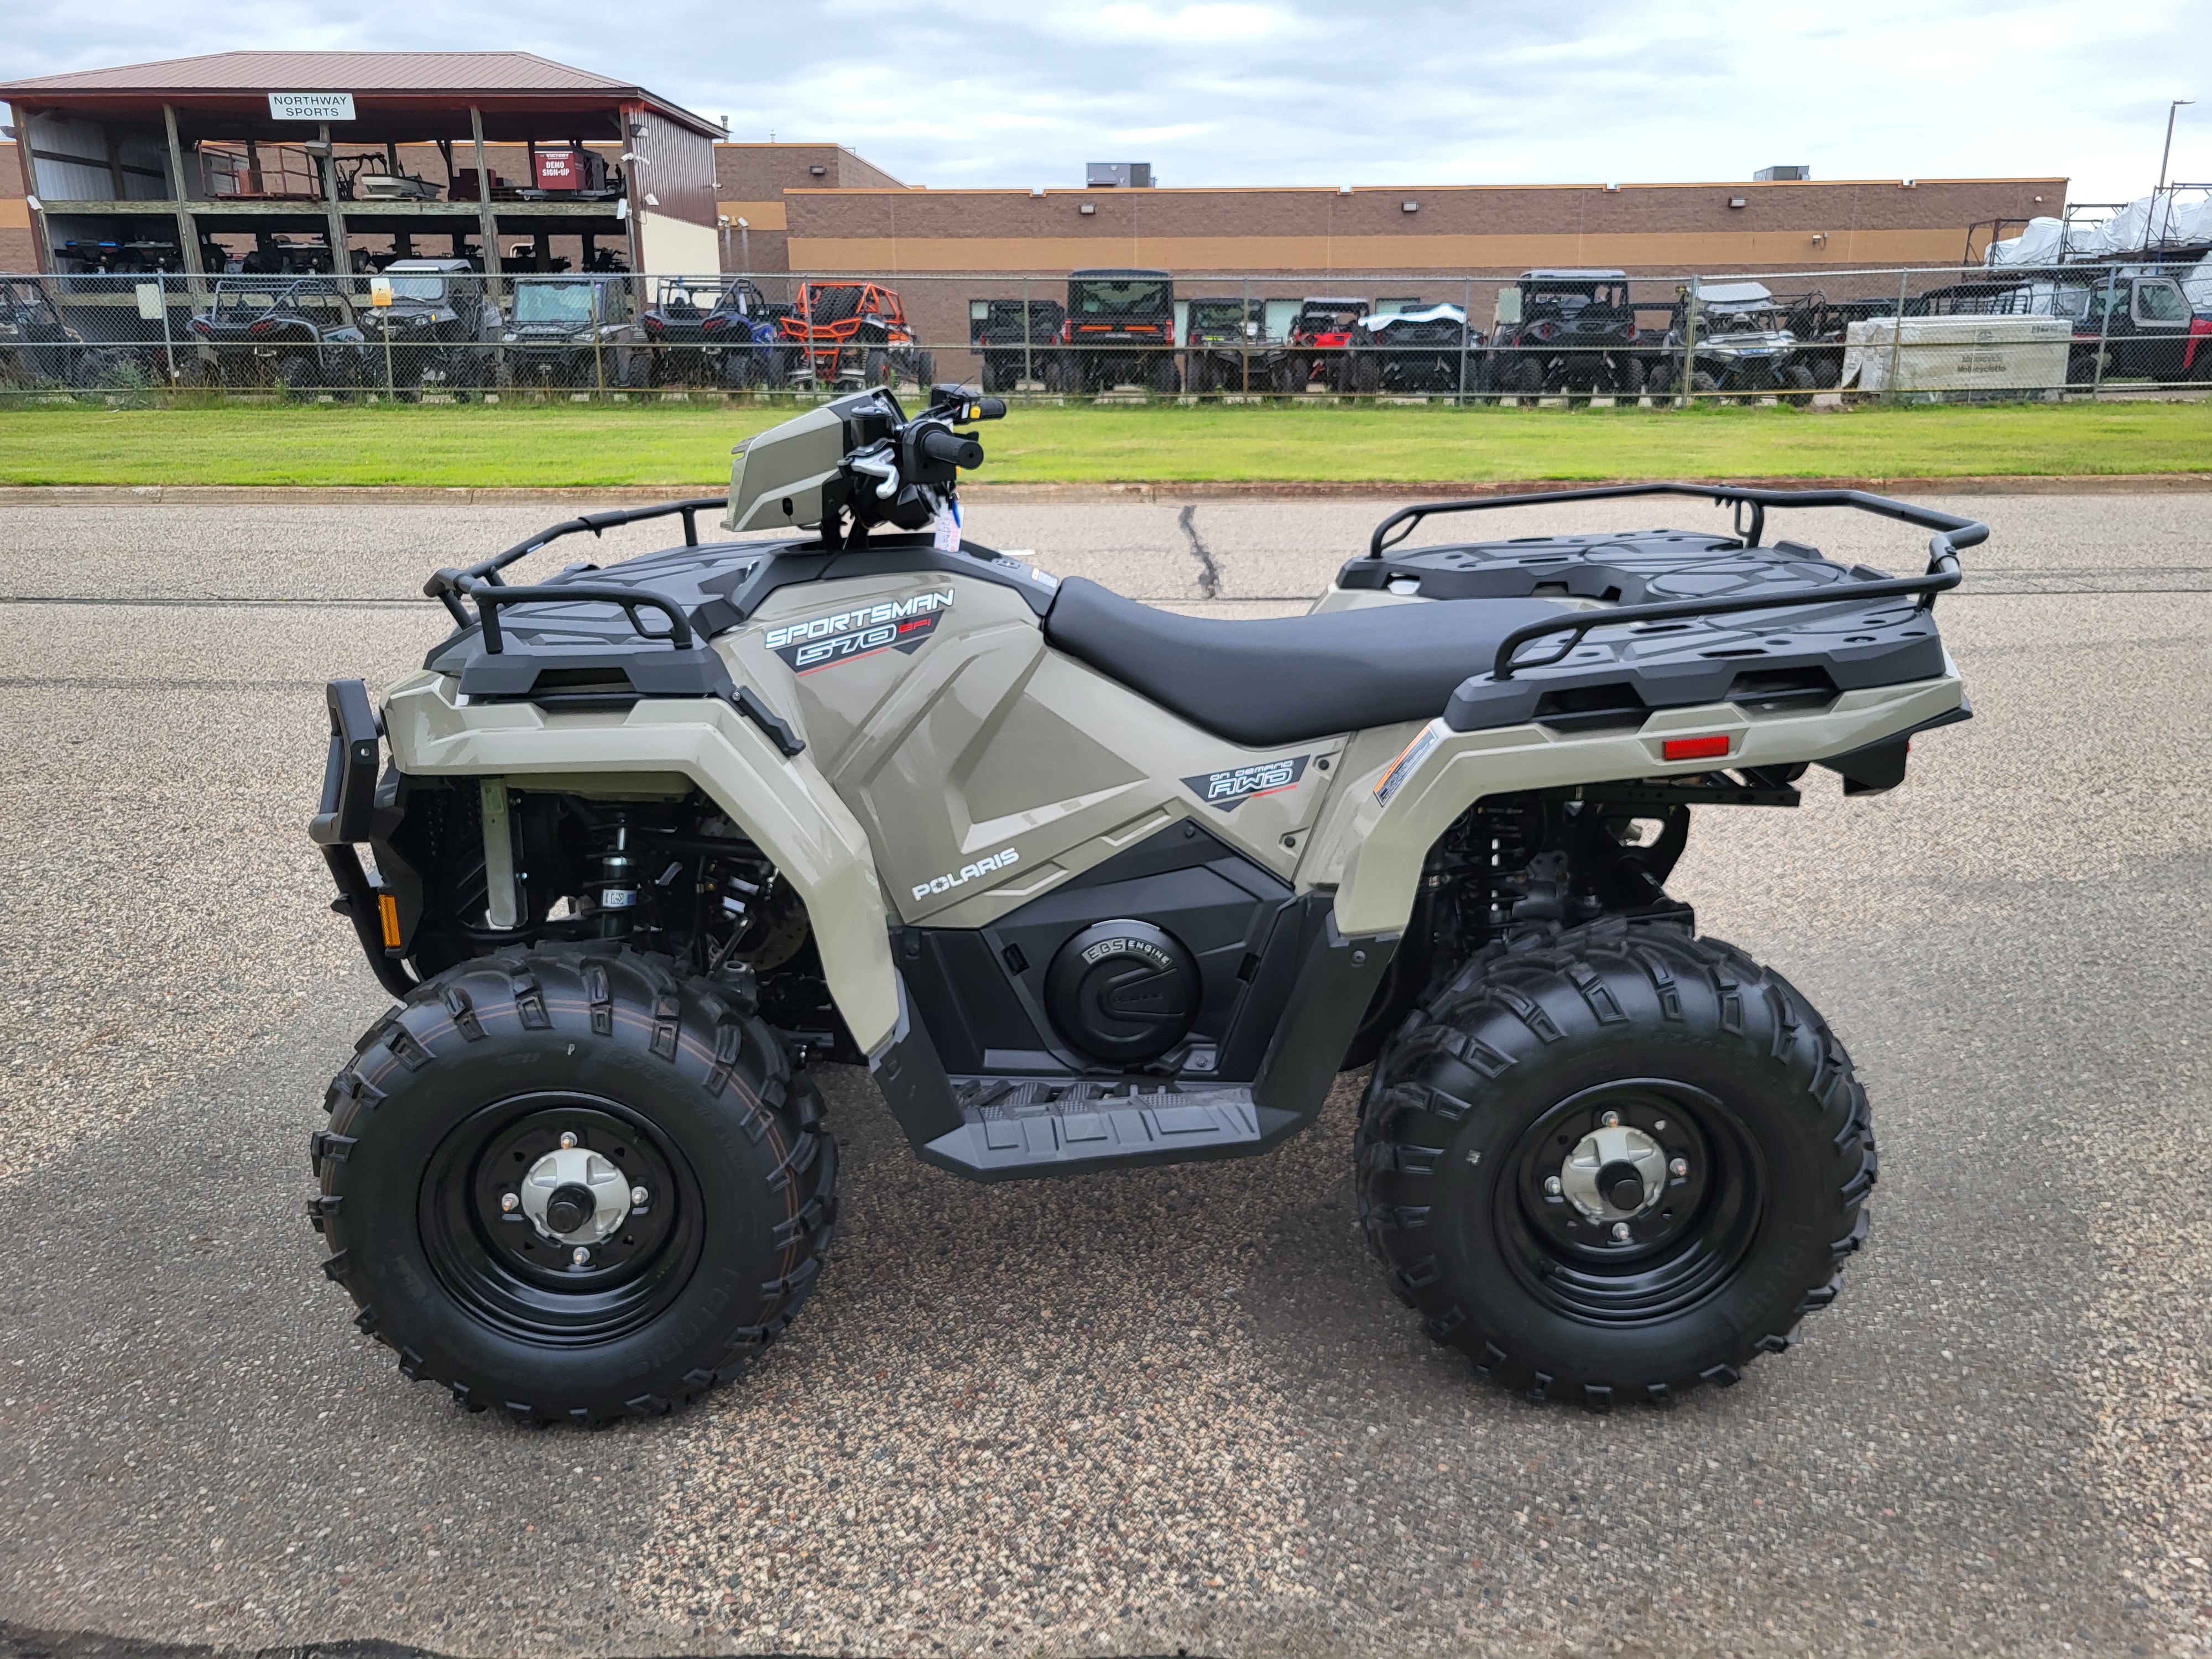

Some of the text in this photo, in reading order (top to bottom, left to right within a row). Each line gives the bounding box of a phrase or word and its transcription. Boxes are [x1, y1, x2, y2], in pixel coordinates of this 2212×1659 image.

[274, 96, 347, 105] NORTHWAY
[286, 108, 339, 117] SPORTS
[542, 168, 570, 176] SIGN-UP
[765, 587, 955, 649] SPORTSMAN
[795, 618, 931, 666] 570 EFI
[1207, 767, 1293, 799] AWD
[911, 847, 1020, 901] POLARIS
[1087, 940, 1171, 965] EBS ENGINE
